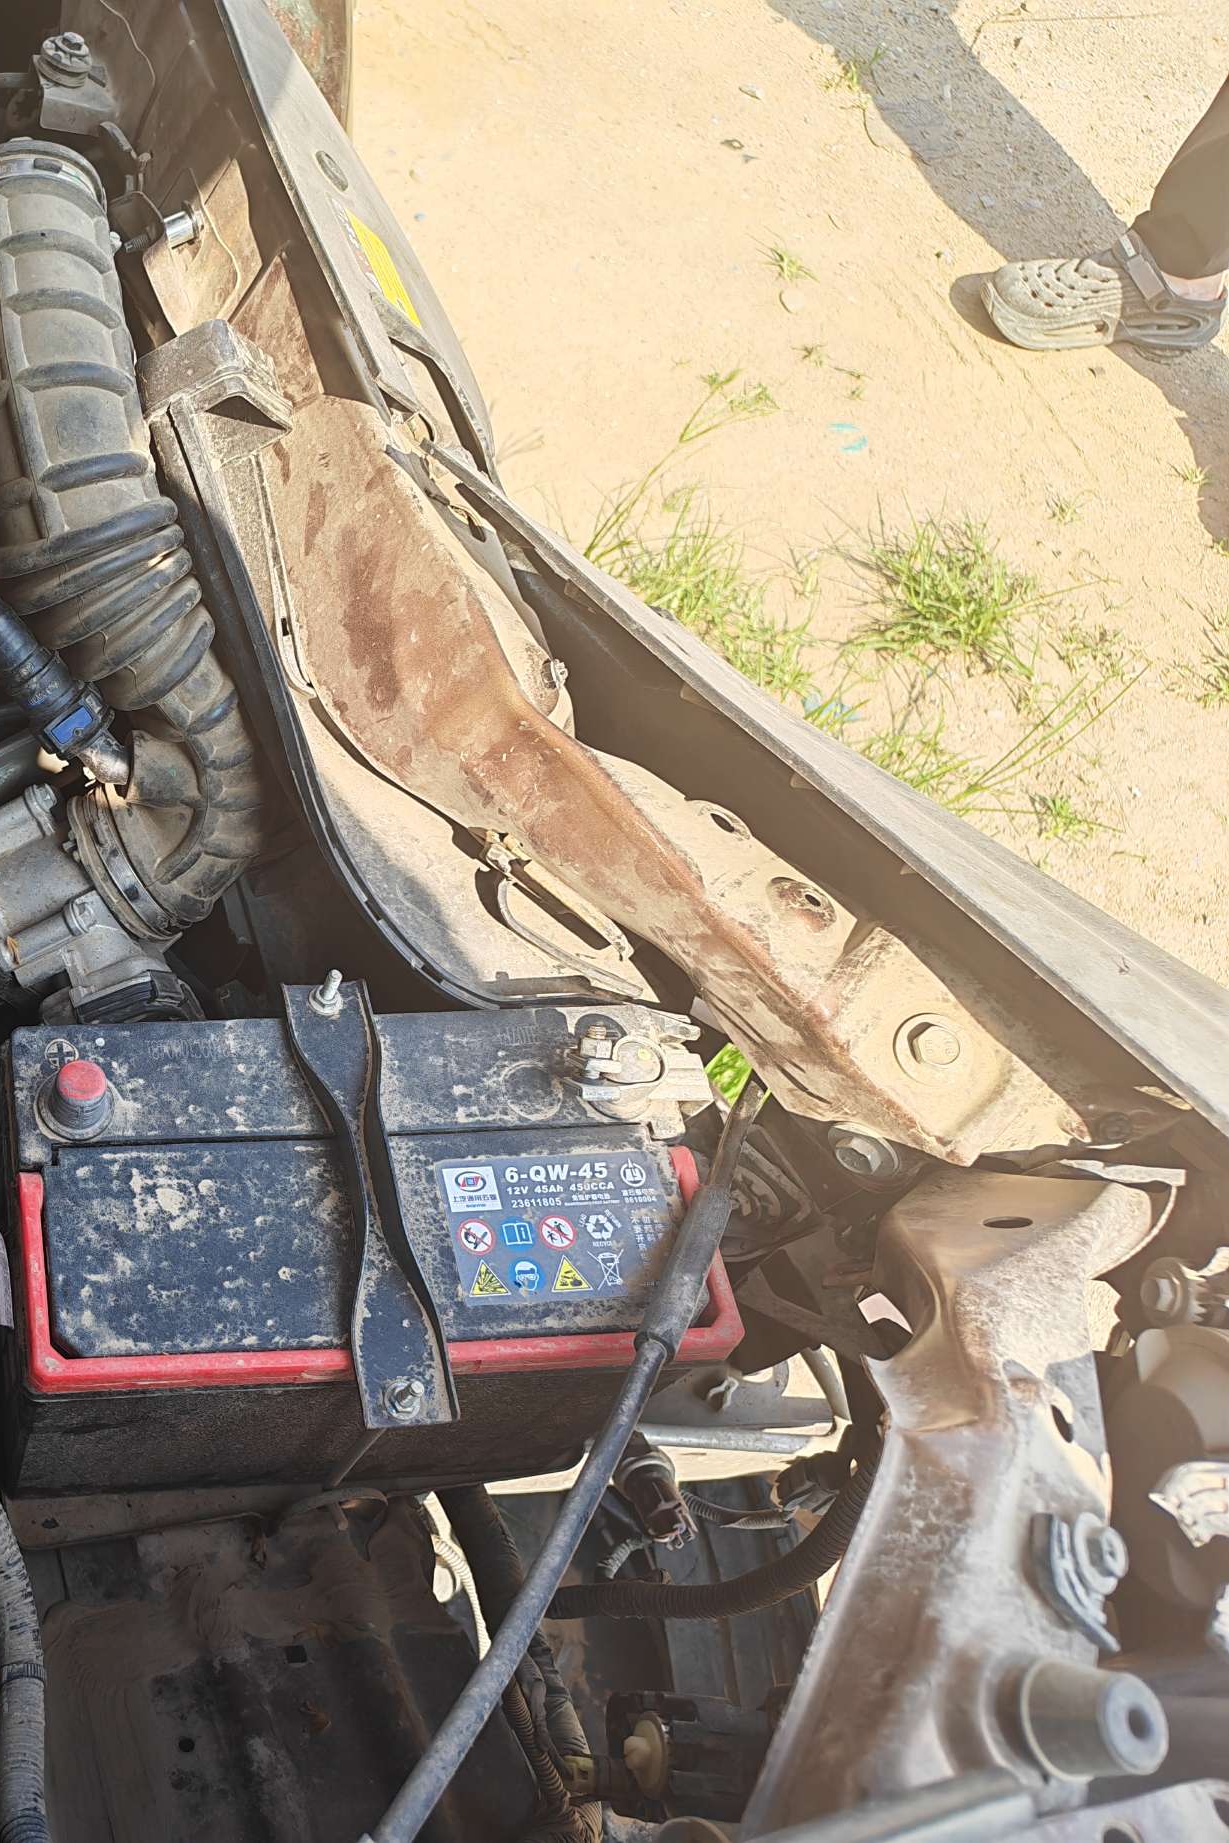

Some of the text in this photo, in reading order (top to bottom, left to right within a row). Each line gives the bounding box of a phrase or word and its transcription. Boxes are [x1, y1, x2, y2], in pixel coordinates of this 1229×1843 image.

[505, 1162, 608, 1183] 6-QW-45
[506, 1181, 615, 1195] 12V 45Ah 450CCA
[511, 1197, 562, 1209] 23611805
